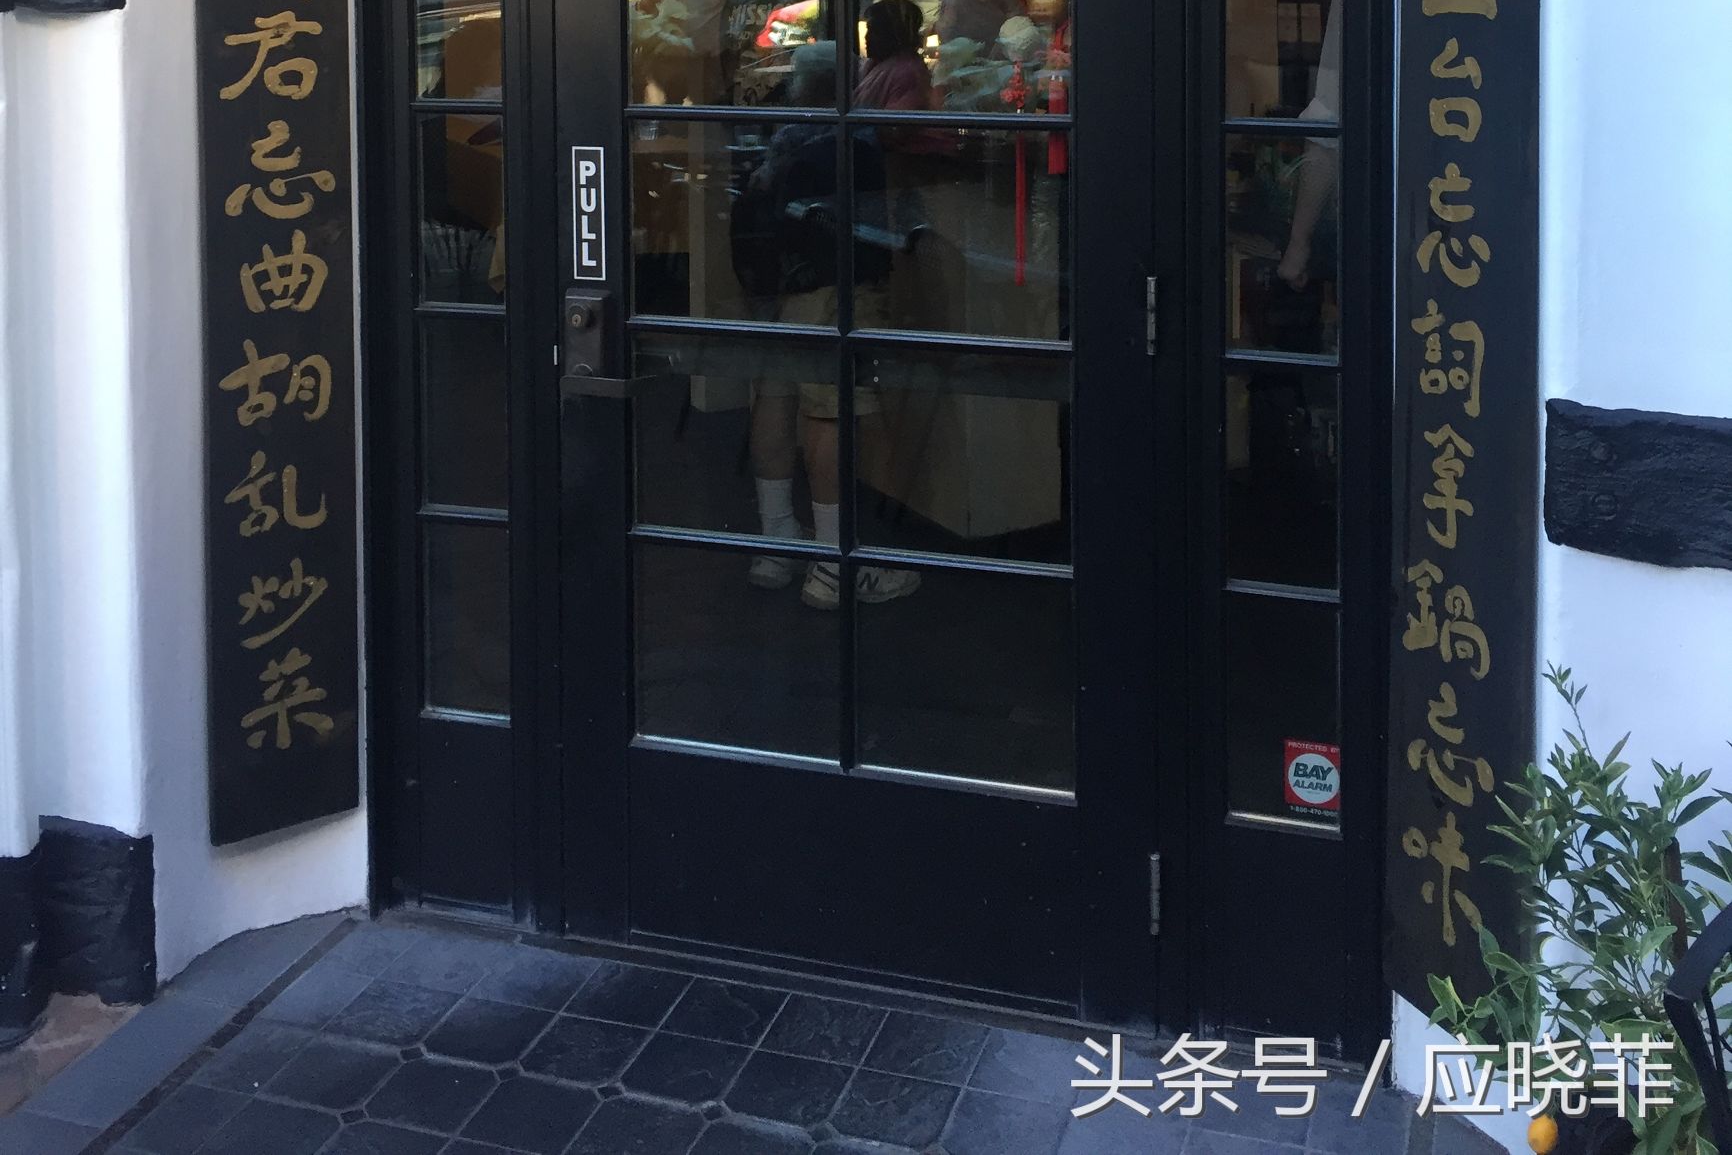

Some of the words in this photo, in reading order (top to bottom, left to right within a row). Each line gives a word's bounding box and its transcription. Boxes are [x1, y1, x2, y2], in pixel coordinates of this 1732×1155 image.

[579, 161, 597, 267] PULL
[1288, 741, 1328, 753] PROTECTED
[1293, 762, 1334, 781] BAY
[1293, 779, 1333, 793] ALARM
